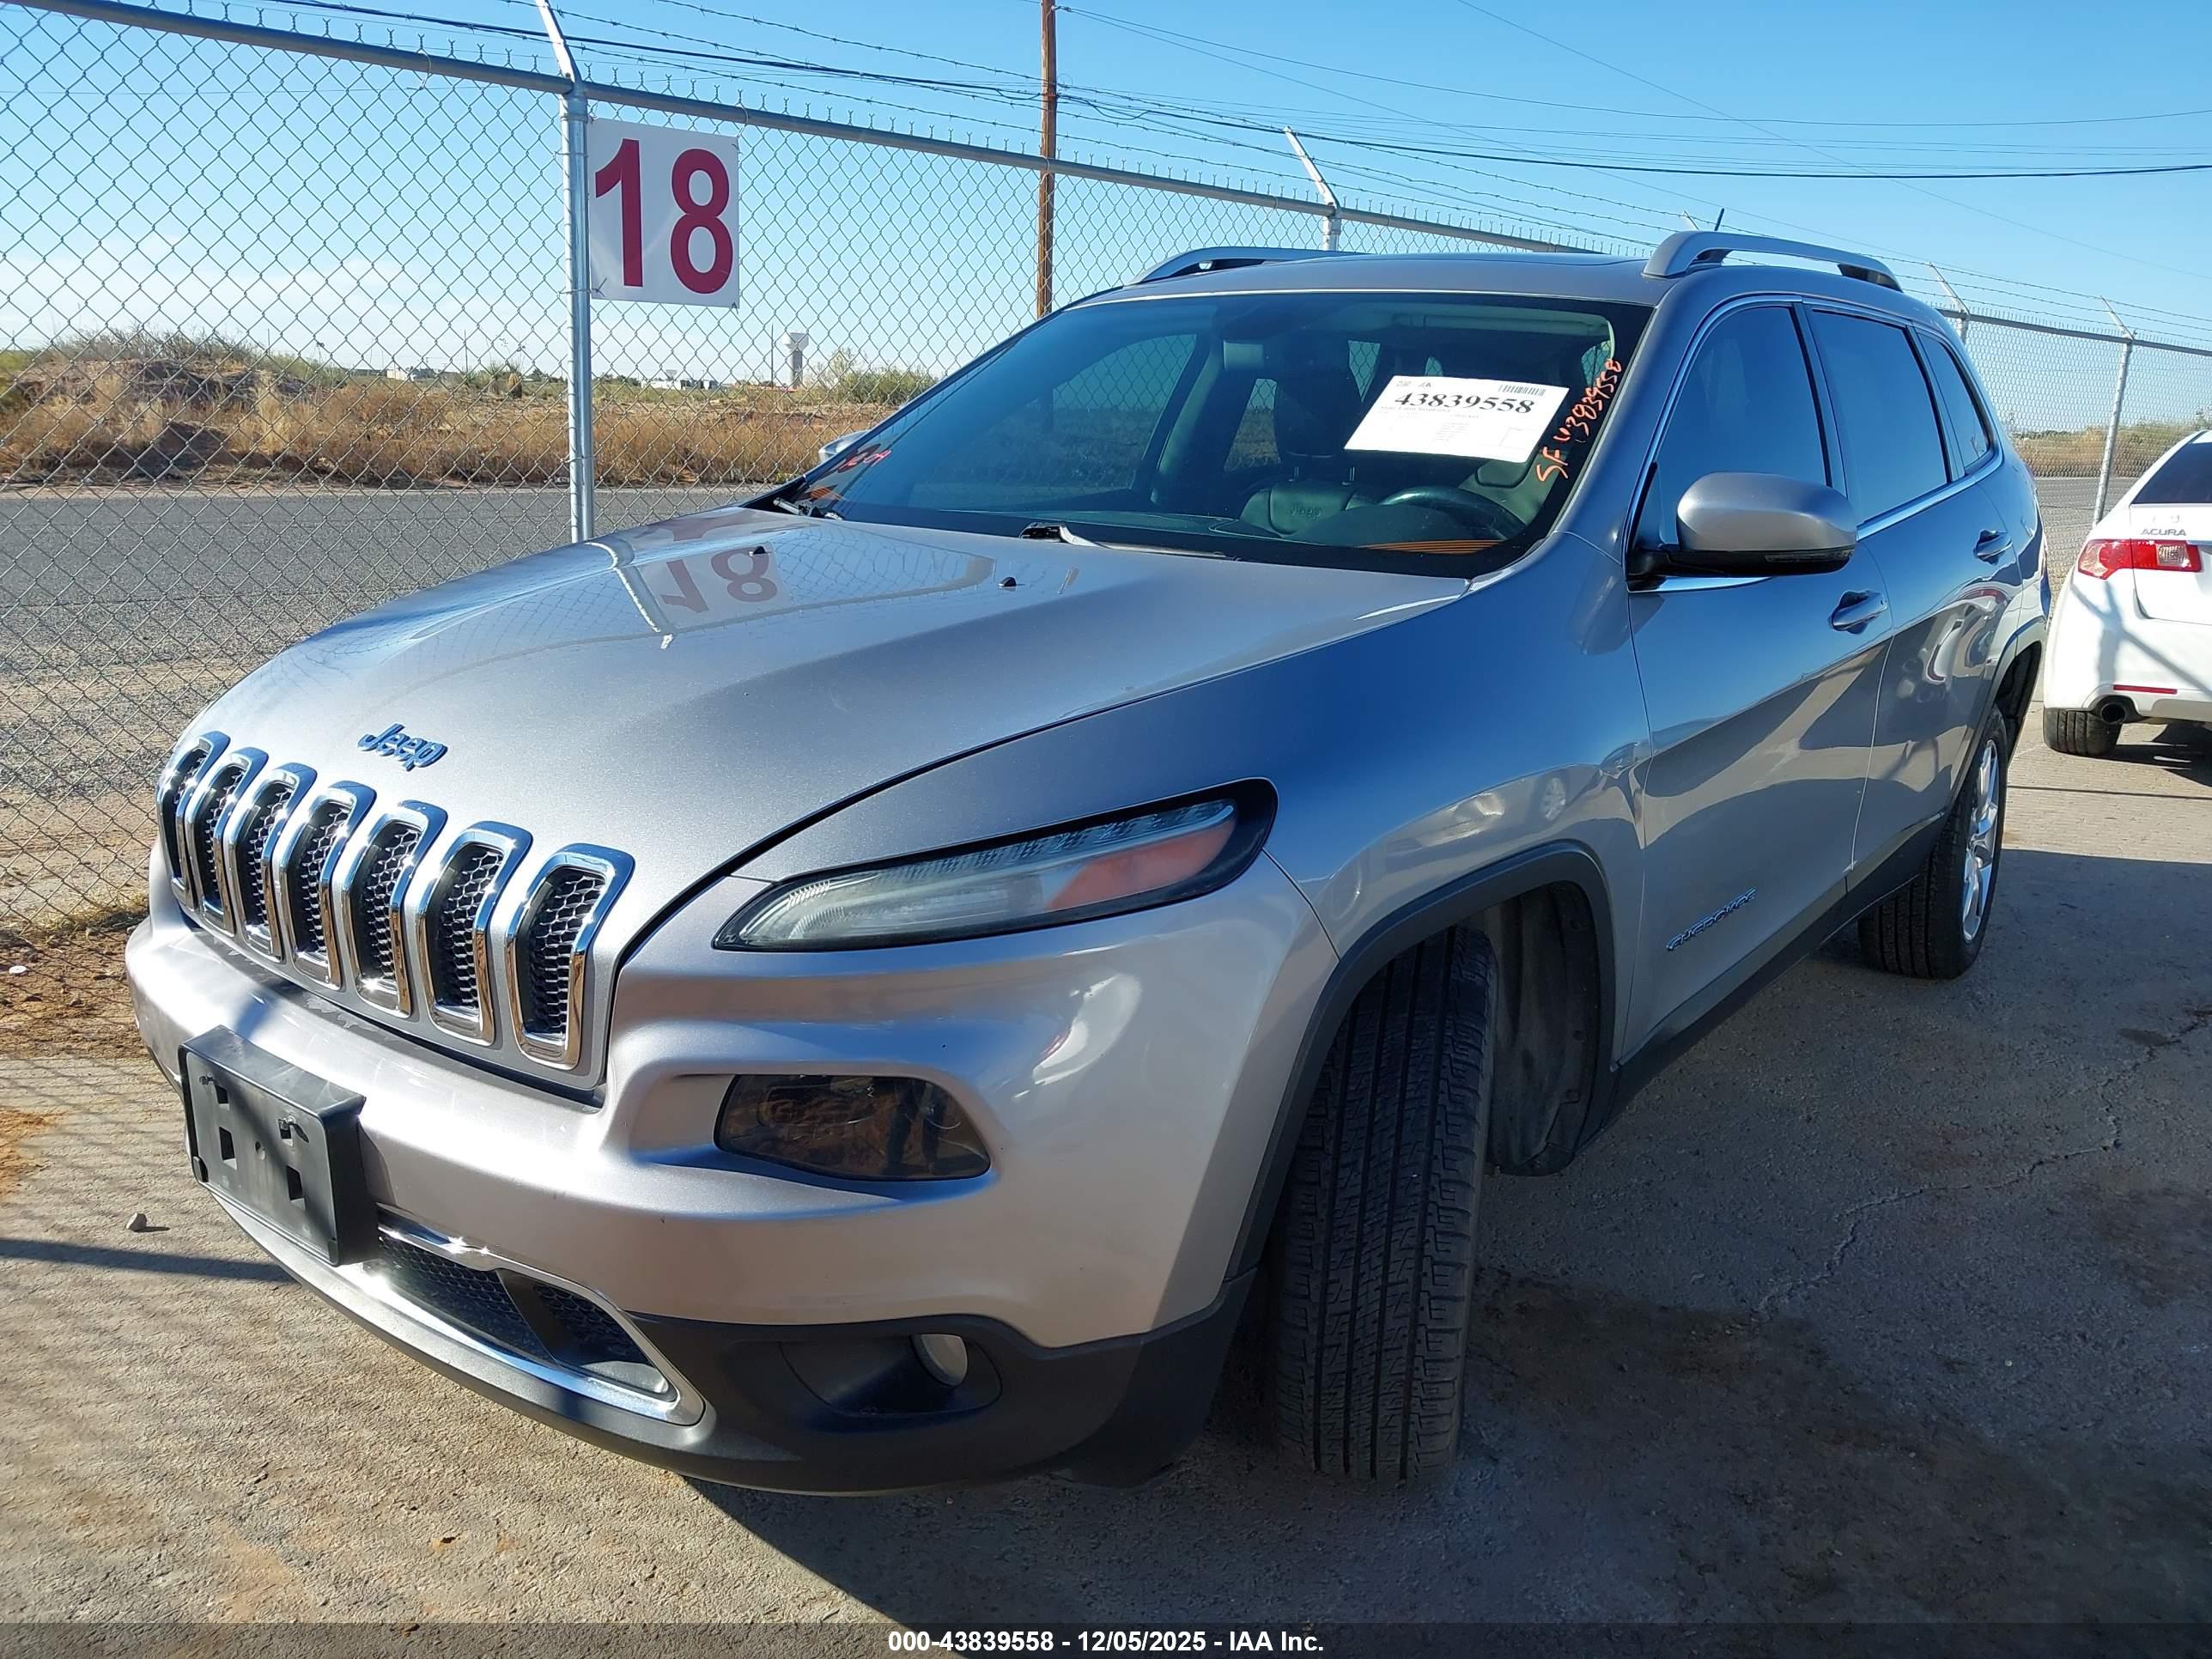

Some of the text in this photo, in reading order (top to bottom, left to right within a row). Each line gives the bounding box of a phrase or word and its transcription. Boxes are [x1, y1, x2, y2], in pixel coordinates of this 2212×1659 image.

[595, 138, 733, 295] 18
[1394, 392, 1535, 414] 43839558
[1536, 447, 1569, 483] SF
[356, 723, 448, 772] Jeep
